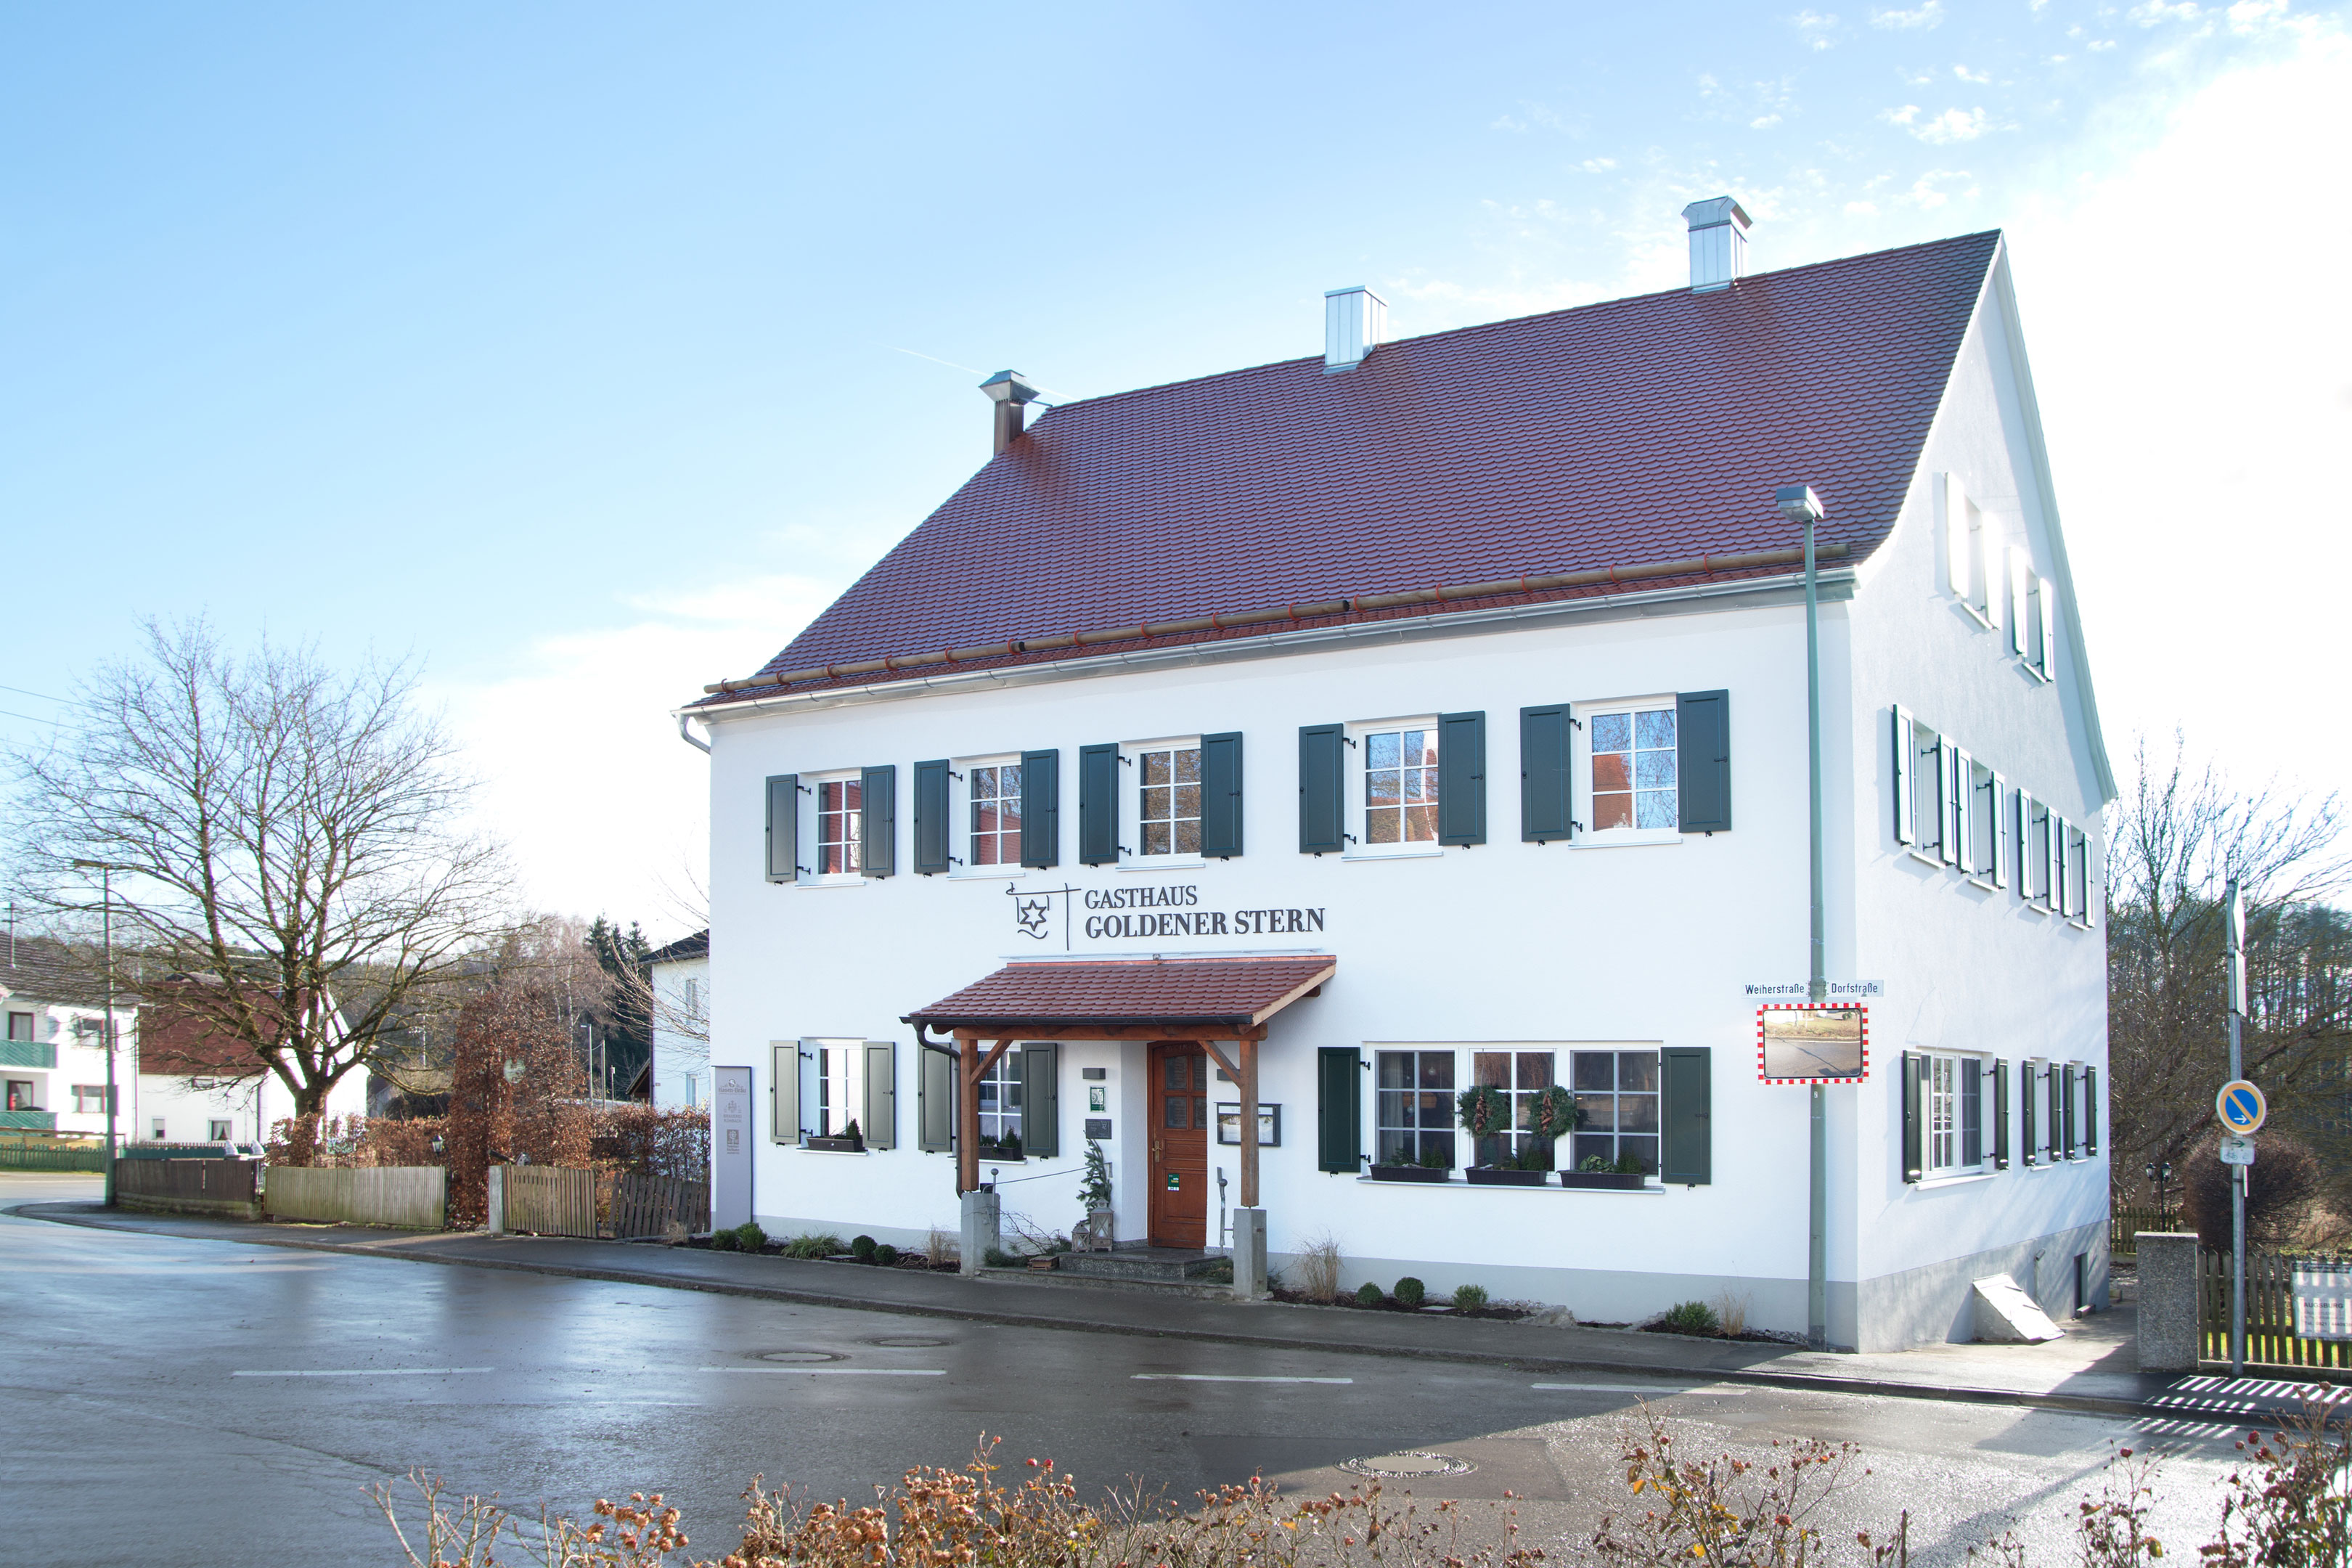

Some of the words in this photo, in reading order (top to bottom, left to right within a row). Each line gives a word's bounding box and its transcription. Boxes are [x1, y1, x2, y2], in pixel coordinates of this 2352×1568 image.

[1085, 885, 1198, 910] GASTHAUS
[1085, 912, 1229, 939] GOLDENER
[1235, 907, 1326, 934] STERN
[1745, 984, 1805, 995] Weiherstraße
[1832, 982, 1878, 993] Dorfstraße
